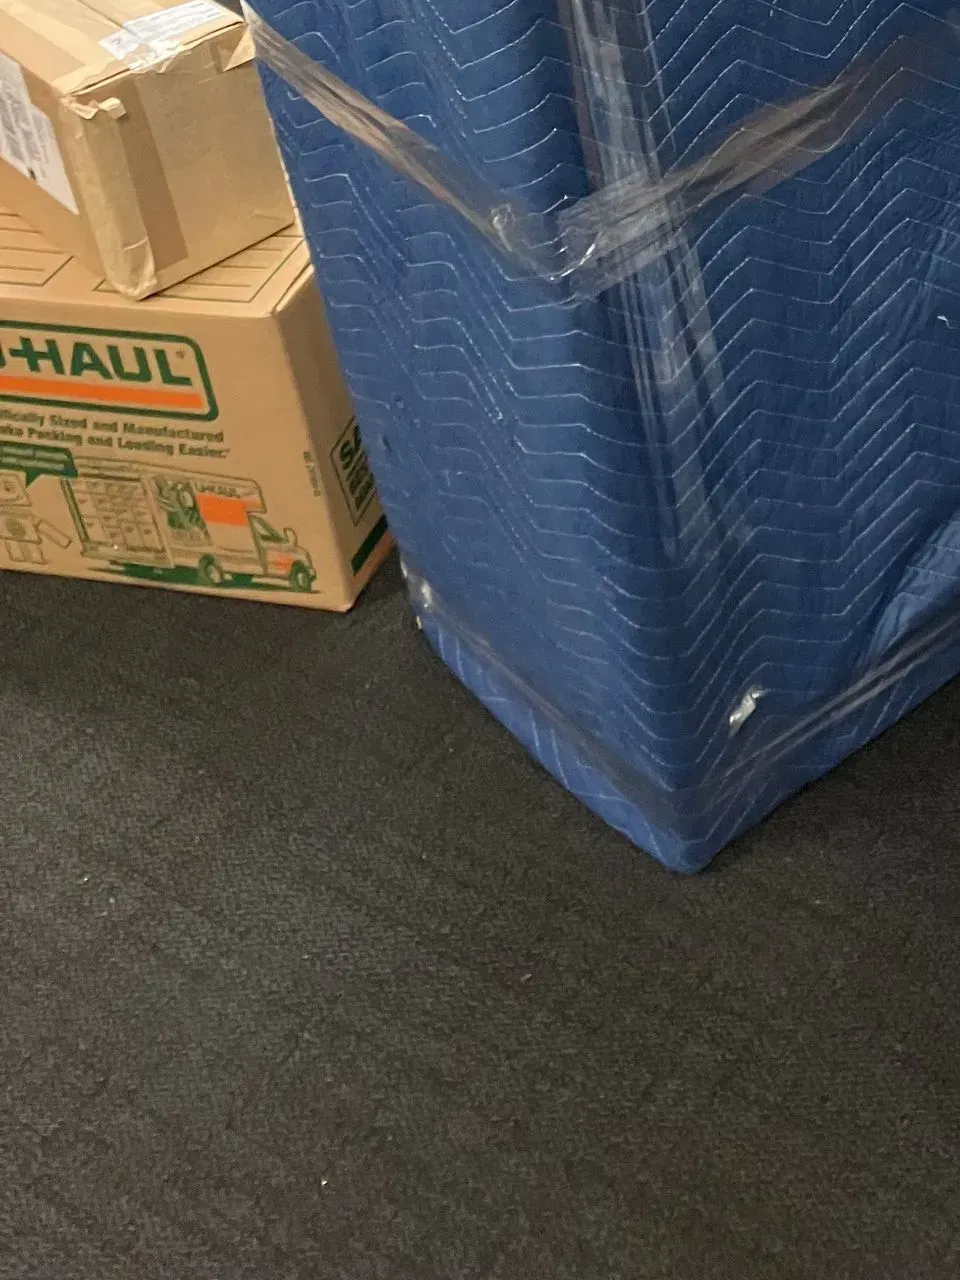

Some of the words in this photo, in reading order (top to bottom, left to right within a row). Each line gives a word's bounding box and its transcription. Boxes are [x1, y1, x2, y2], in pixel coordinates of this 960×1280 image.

[0, 335, 192, 386] -HAUL
[87, 435, 113, 447] and
[92, 422, 118, 433] and
[123, 423, 224, 443] Manufactured
